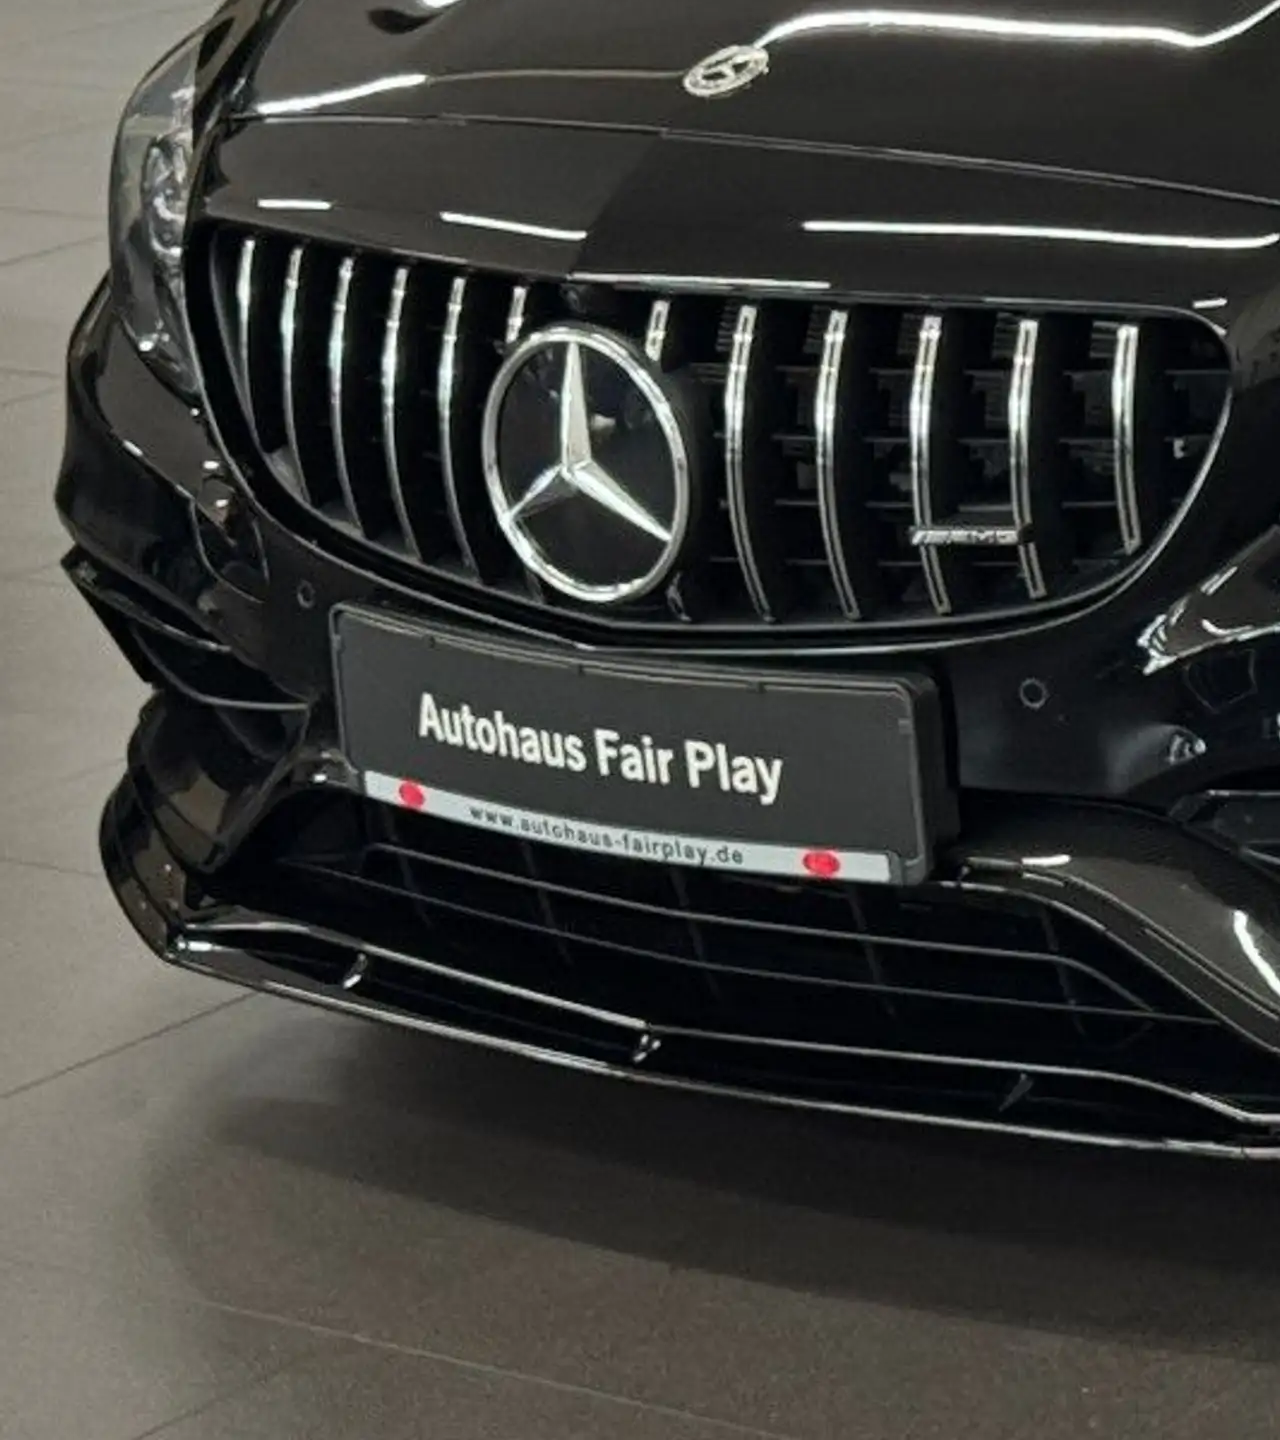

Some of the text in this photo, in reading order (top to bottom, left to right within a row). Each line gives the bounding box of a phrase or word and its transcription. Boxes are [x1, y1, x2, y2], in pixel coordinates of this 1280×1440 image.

[419, 692, 783, 805] Autohaus Fair Play
[469, 806, 744, 865] www.autohaus-fairplay.de
